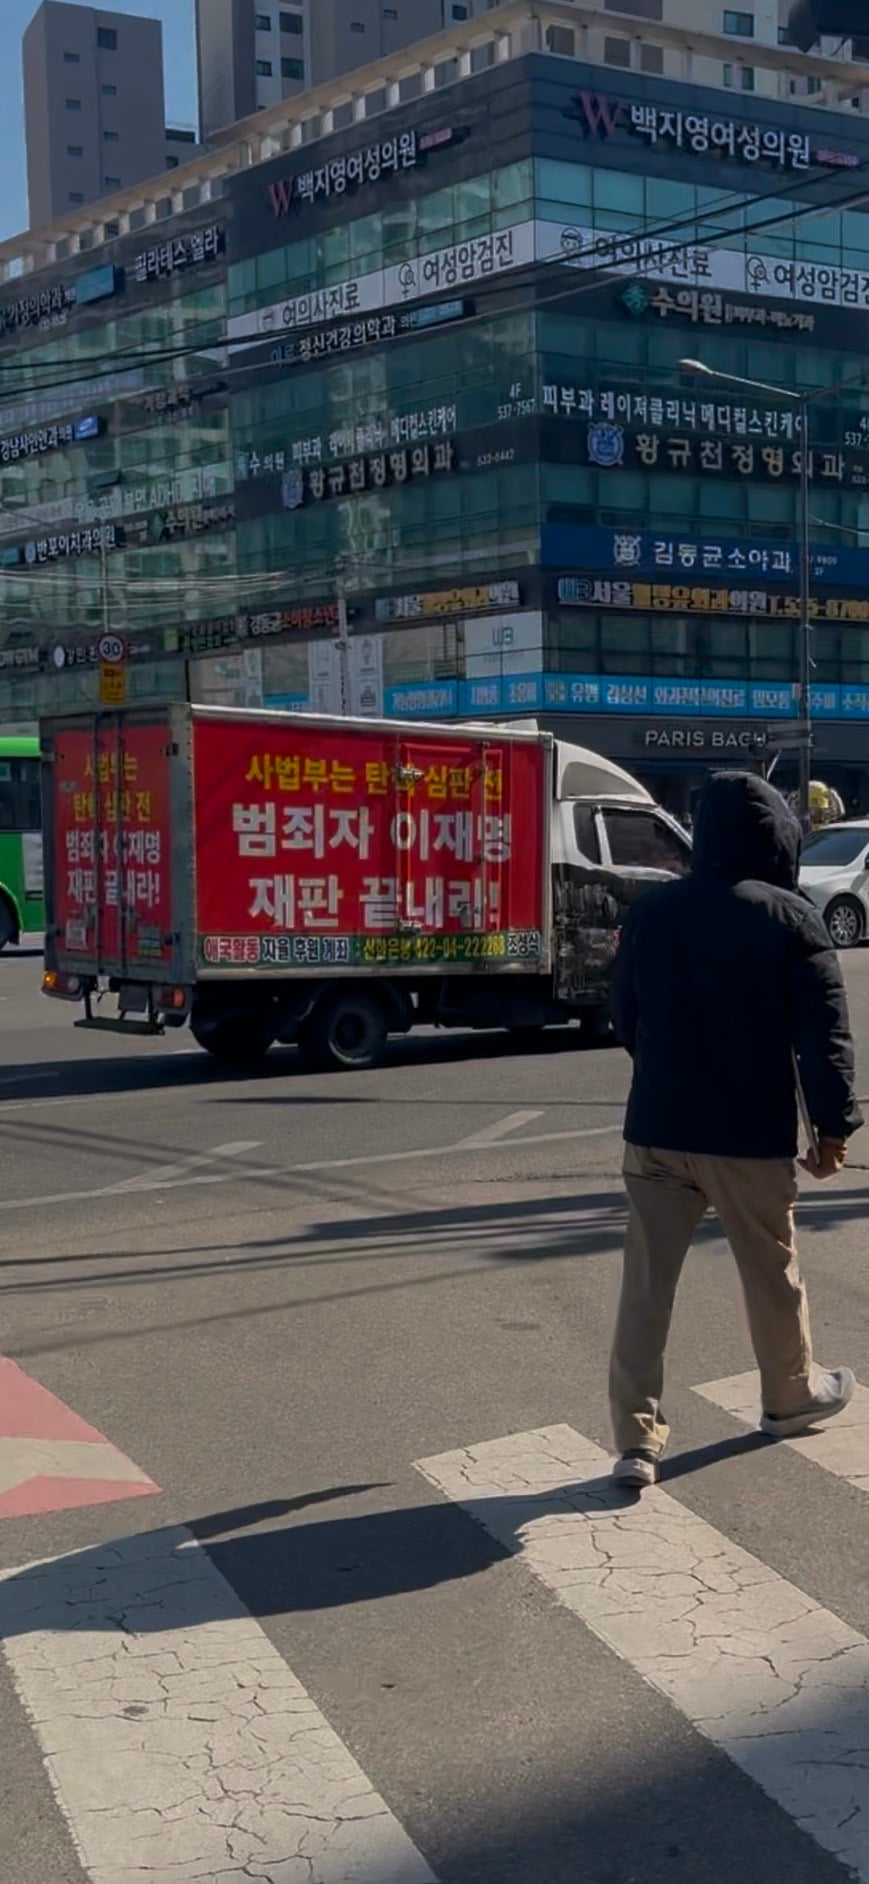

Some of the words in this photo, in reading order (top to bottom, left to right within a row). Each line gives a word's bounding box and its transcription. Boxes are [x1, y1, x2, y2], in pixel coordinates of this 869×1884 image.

[580, 92, 620, 137] W
[631, 105, 810, 169] 백지영여성의원
[298, 130, 416, 202] 백지영여성의원
[268, 179, 295, 216] W
[135, 240, 188, 282] 필라테스
[423, 231, 513, 288] 여성암검진
[596, 234, 712, 278] 여의사진료
[282, 283, 360, 326] 여의사진료
[651, 288, 723, 324] 수의원
[299, 315, 398, 361] 정신건강의학과
[542, 385, 595, 417] 피부과
[391, 404, 457, 443] 메디컬스킨케어
[309, 441, 454, 498] 황규천정형외과
[635, 432, 846, 482] 황규천정형외과
[37, 525, 115, 561] 반포이치과의원
[653, 540, 792, 573] 김동균소아과
[102, 641, 120, 656] 30
[645, 731, 705, 747] PARIS
[245, 754, 355, 793] 사법부는
[425, 764, 474, 799] 심판
[136, 792, 153, 823] 전
[231, 802, 375, 860] 범죄자
[390, 807, 512, 863] 이재명
[249, 874, 344, 929] 재판
[359, 876, 501, 931] 끝내라!
[294, 936, 320, 964] 후원
[322, 936, 350, 963] 계좌
